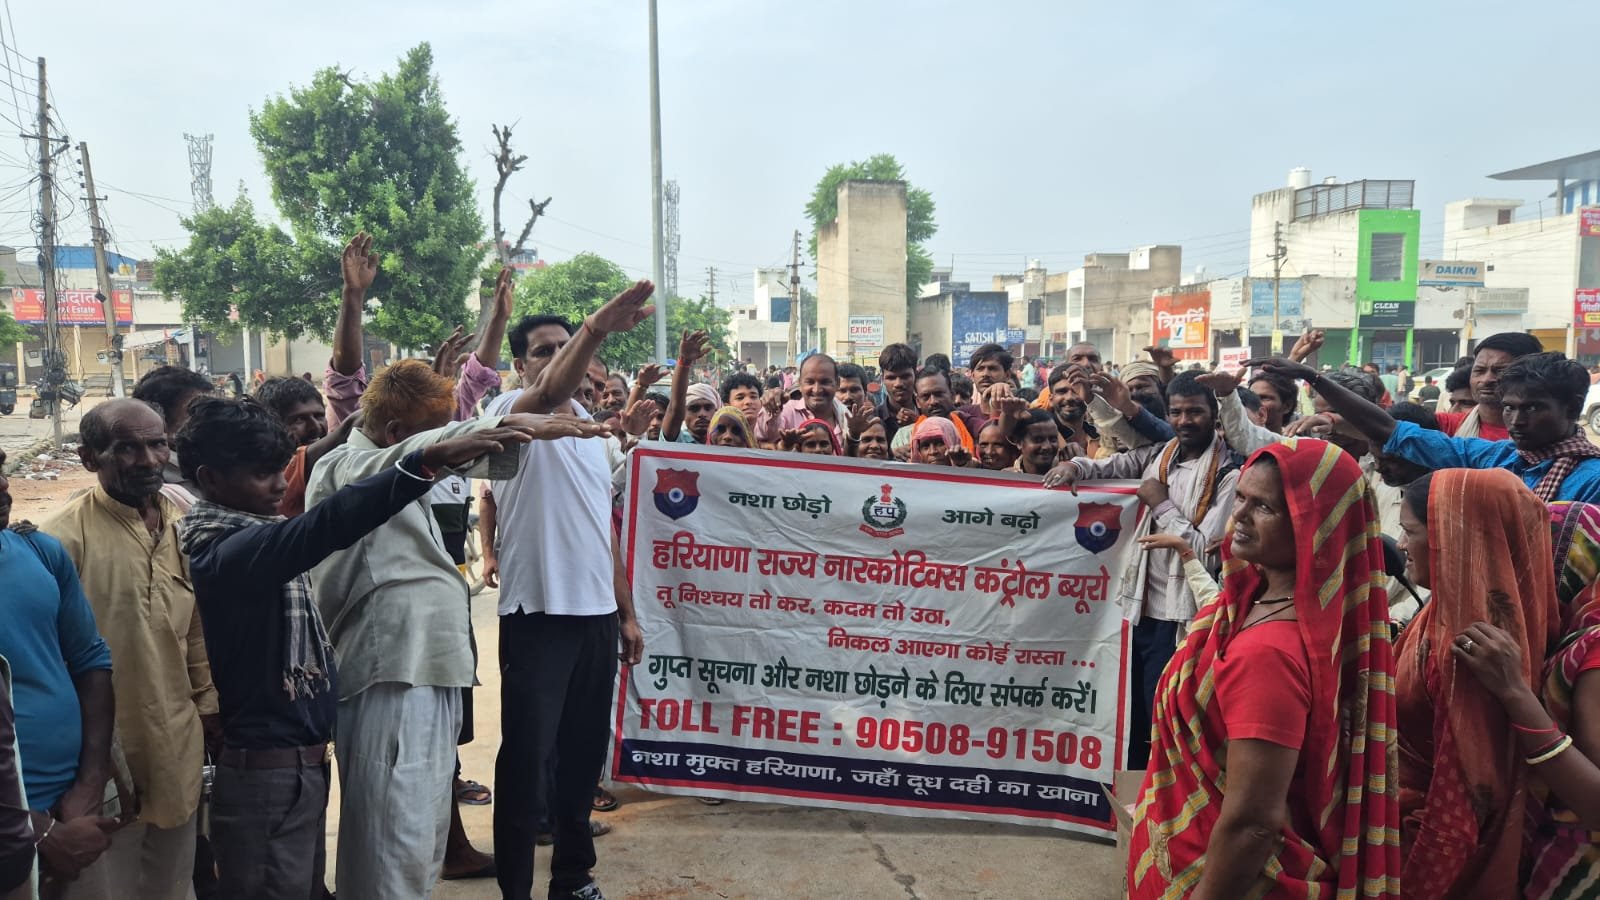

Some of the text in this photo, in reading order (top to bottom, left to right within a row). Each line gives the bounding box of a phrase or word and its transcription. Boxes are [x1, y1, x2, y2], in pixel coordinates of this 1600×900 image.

[1435, 265, 1478, 275] DAIKIN
[965, 332, 994, 343] SATISH
[1156, 307, 1205, 330] त्रिमर्ति
[728, 492, 832, 519] नशा छोड़ो
[942, 507, 1040, 534] आगे बढ़ो
[653, 530, 1111, 614] हरियाणा राज्य नारकोटिक्स कंट्रोल ब्यूरो
[656, 586, 676, 609] तू
[678, 582, 744, 608] निश्चय
[749, 589, 773, 610] तो
[823, 600, 877, 618] कदम
[882, 600, 905, 621] तो
[910, 606, 950, 627] उठा,
[827, 626, 892, 654] निकल
[894, 639, 961, 659] आएगा
[965, 641, 1011, 665] कोई
[1015, 649, 1066, 666] रास्ता
[648, 655, 693, 690] गुप्त
[698, 658, 757, 694] सूचना
[760, 655, 802, 690] और
[805, 667, 850, 694] नशा
[854, 664, 911, 709] छोड़ने
[915, 670, 939, 700] के
[944, 671, 986, 707] लिए
[991, 677, 1049, 708] संपर्क
[638, 698, 719, 734] TOLL
[731, 704, 821, 745] FREE
[855, 716, 1102, 770] 90508-91508
[632, 750, 1100, 806] नशा मुक्त हरियाणा, जहाँ दूध दही का खाना
